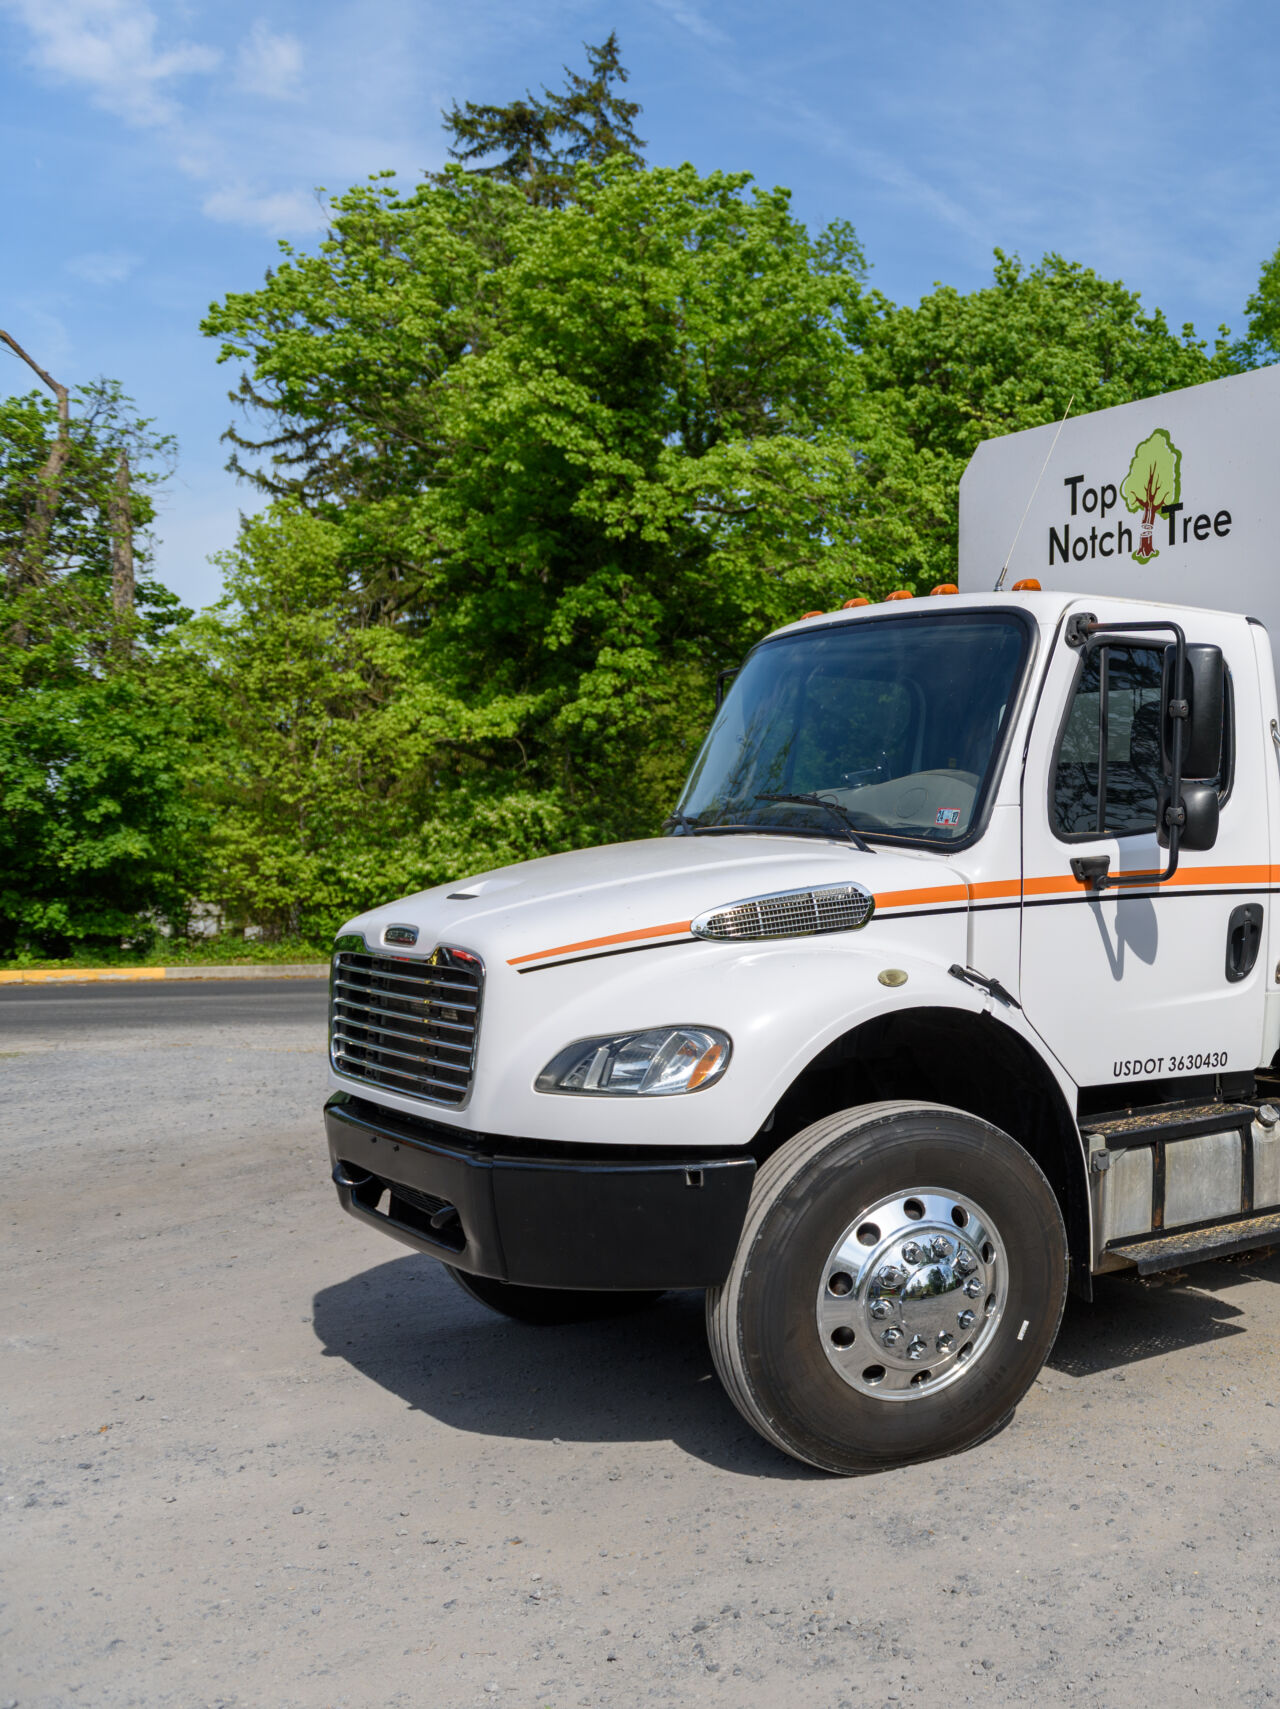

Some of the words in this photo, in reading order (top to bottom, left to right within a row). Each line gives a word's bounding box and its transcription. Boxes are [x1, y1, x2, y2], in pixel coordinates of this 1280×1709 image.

[1064, 474, 1117, 518] Top
[1048, 521, 1133, 565] Notch
[1161, 502, 1232, 546] Tree
[1113, 1057, 1164, 1077] USDOT
[1168, 1051, 1228, 1073] 3630430
